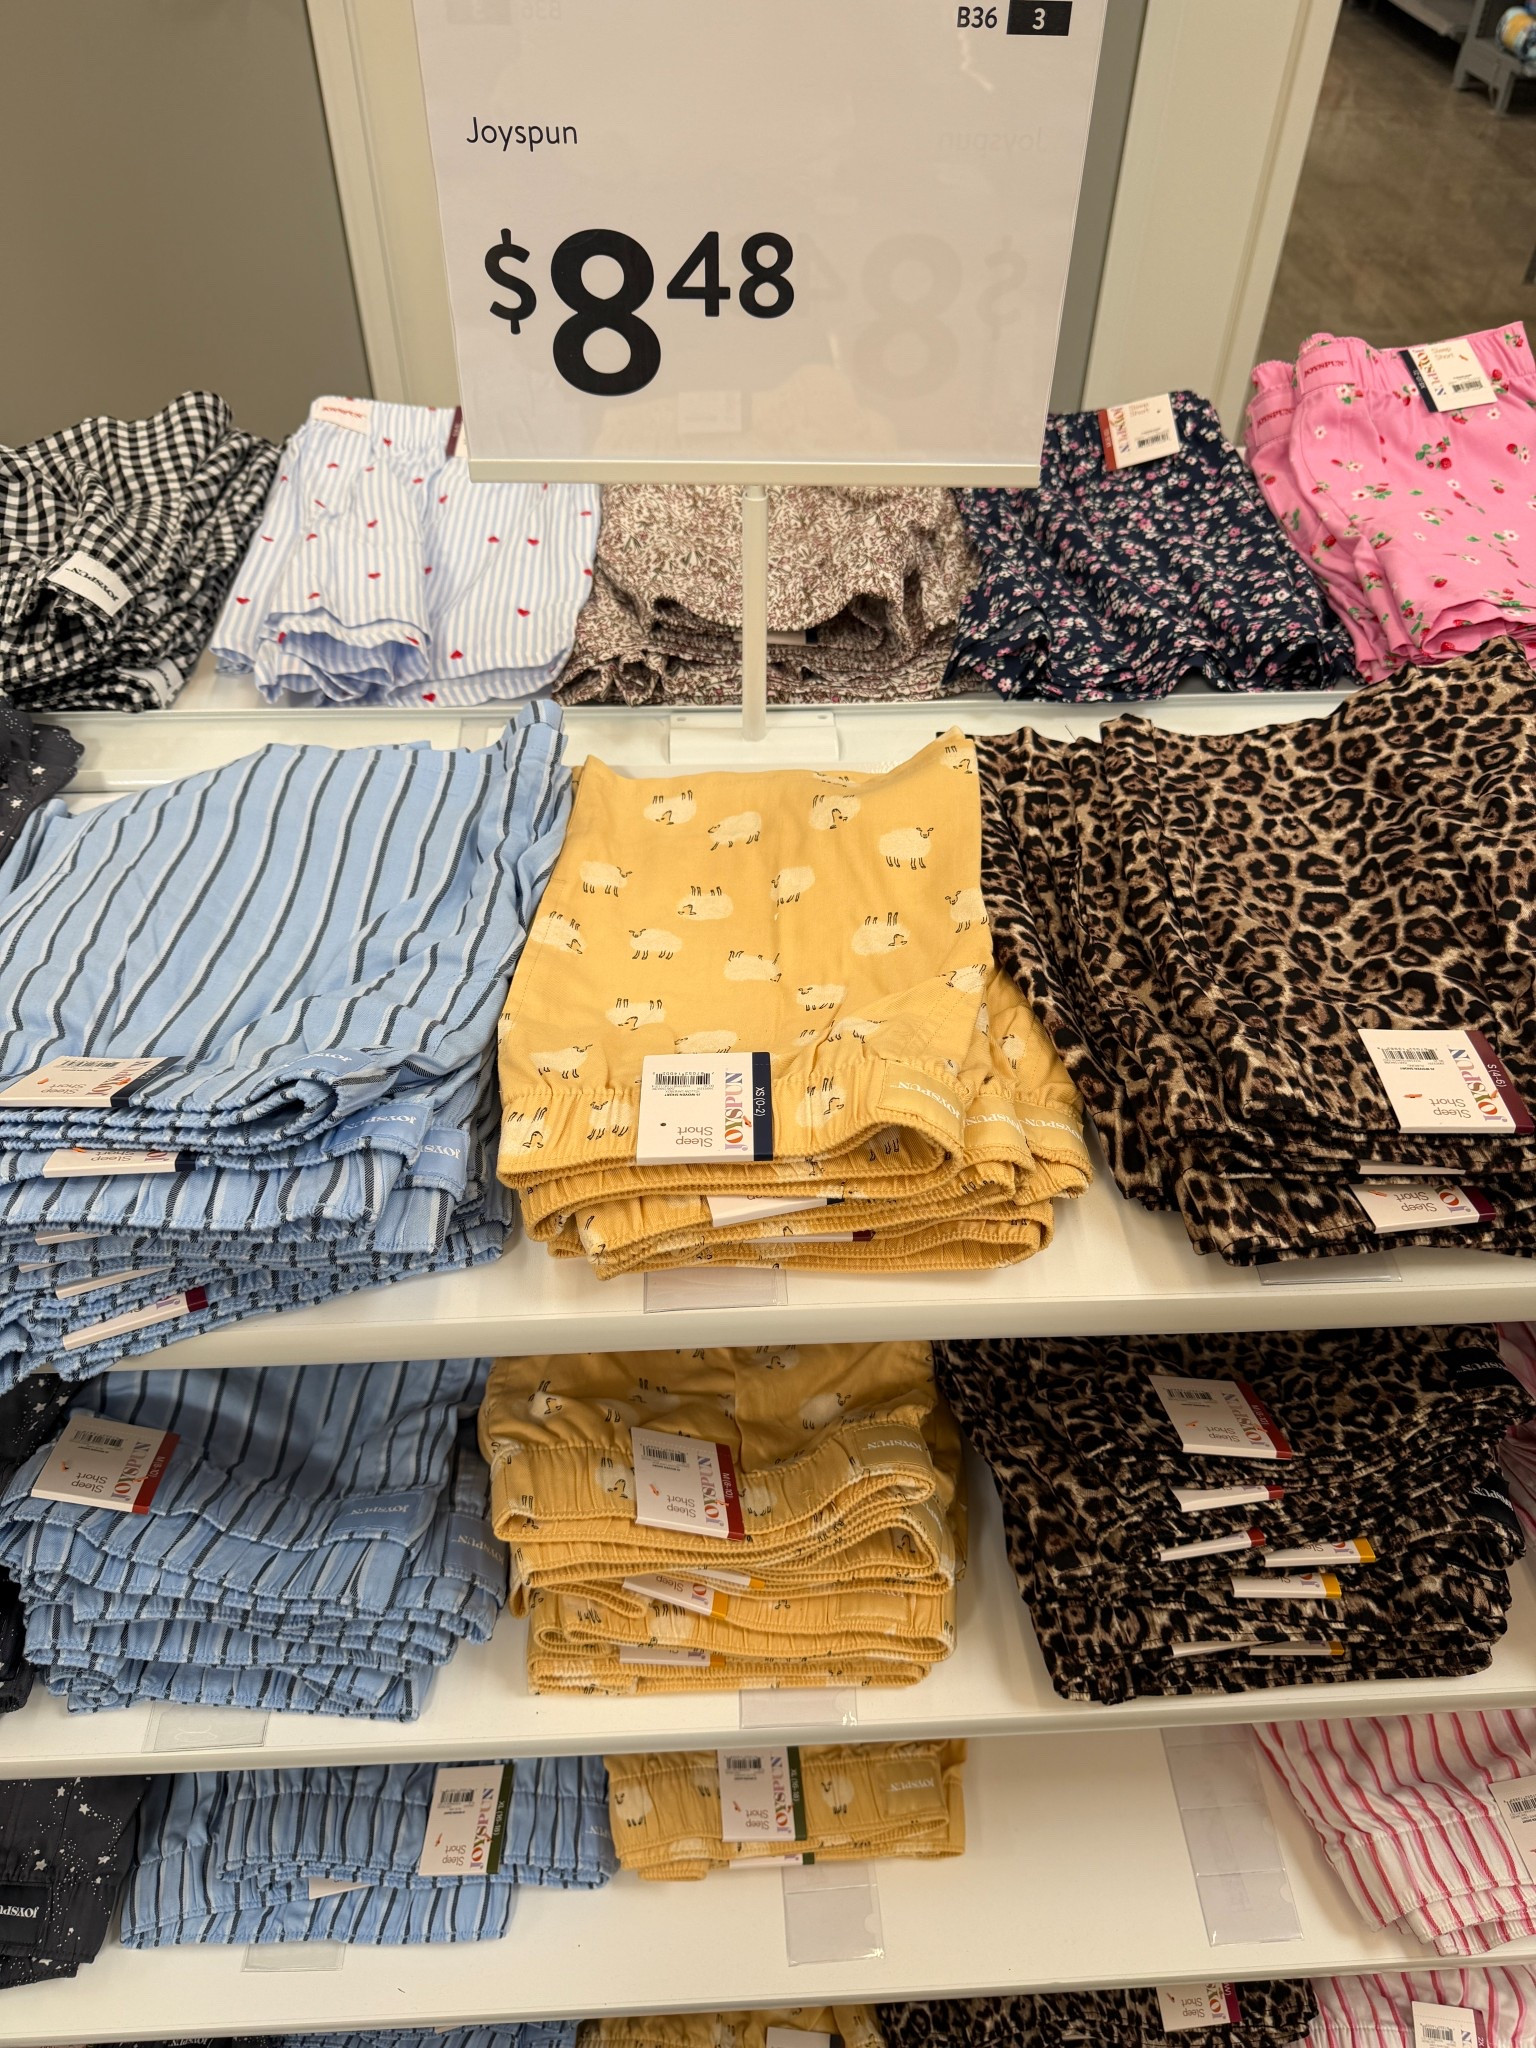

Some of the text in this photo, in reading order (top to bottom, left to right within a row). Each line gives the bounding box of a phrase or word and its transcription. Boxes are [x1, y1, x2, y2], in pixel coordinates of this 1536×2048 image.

[956, 6, 1046, 30] B36 3
[466, 116, 578, 152] Joyspun
[1304, 360, 1345, 378] JOYSPUN
[71, 567, 120, 602] JOYSPUN
[1487, 1063, 1507, 1088] S (4-6)
[1449, 1048, 1508, 1122] JOYSPUN
[753, 1086, 766, 1117] XS (0-2)
[898, 1081, 961, 1119] JOYSPUN
[1429, 1098, 1466, 1108] Short
[725, 1072, 748, 1151] JOYSPUN
[1433, 1109, 1472, 1119] Sleep
[343, 1115, 417, 1131] JOYSPUN
[677, 1126, 714, 1137] Short
[675, 1137, 713, 1148] Sleep
[1393, 1191, 1429, 1202] Short
[1400, 1202, 1437, 1212] Sleep
[1222, 1392, 1270, 1448] JOYSPUN
[1205, 1426, 1236, 1435] Short
[1208, 1433, 1241, 1443] Sleep
[75, 1472, 108, 1484] Short
[111, 1441, 151, 1501] JOYSPUN
[71, 1480, 105, 1493] Sleep
[697, 1455, 725, 1527] JOYSPUN
[667, 1494, 695, 1508] Short
[667, 1504, 697, 1519] Sleep
[656, 1574, 684, 1593] Sleep
[771, 1756, 792, 1834] JOYSPUN
[745, 1808, 769, 1818] Short
[470, 1788, 494, 1869] JOYSPUN
[746, 1819, 770, 1830] Sleep
[445, 1844, 467, 1855] Short
[442, 1856, 465, 1866] Sleep
[0, 1904, 39, 1918] JOYSPU
[1181, 1997, 1203, 2007] Short
[1183, 2008, 1205, 2018] Sleep
